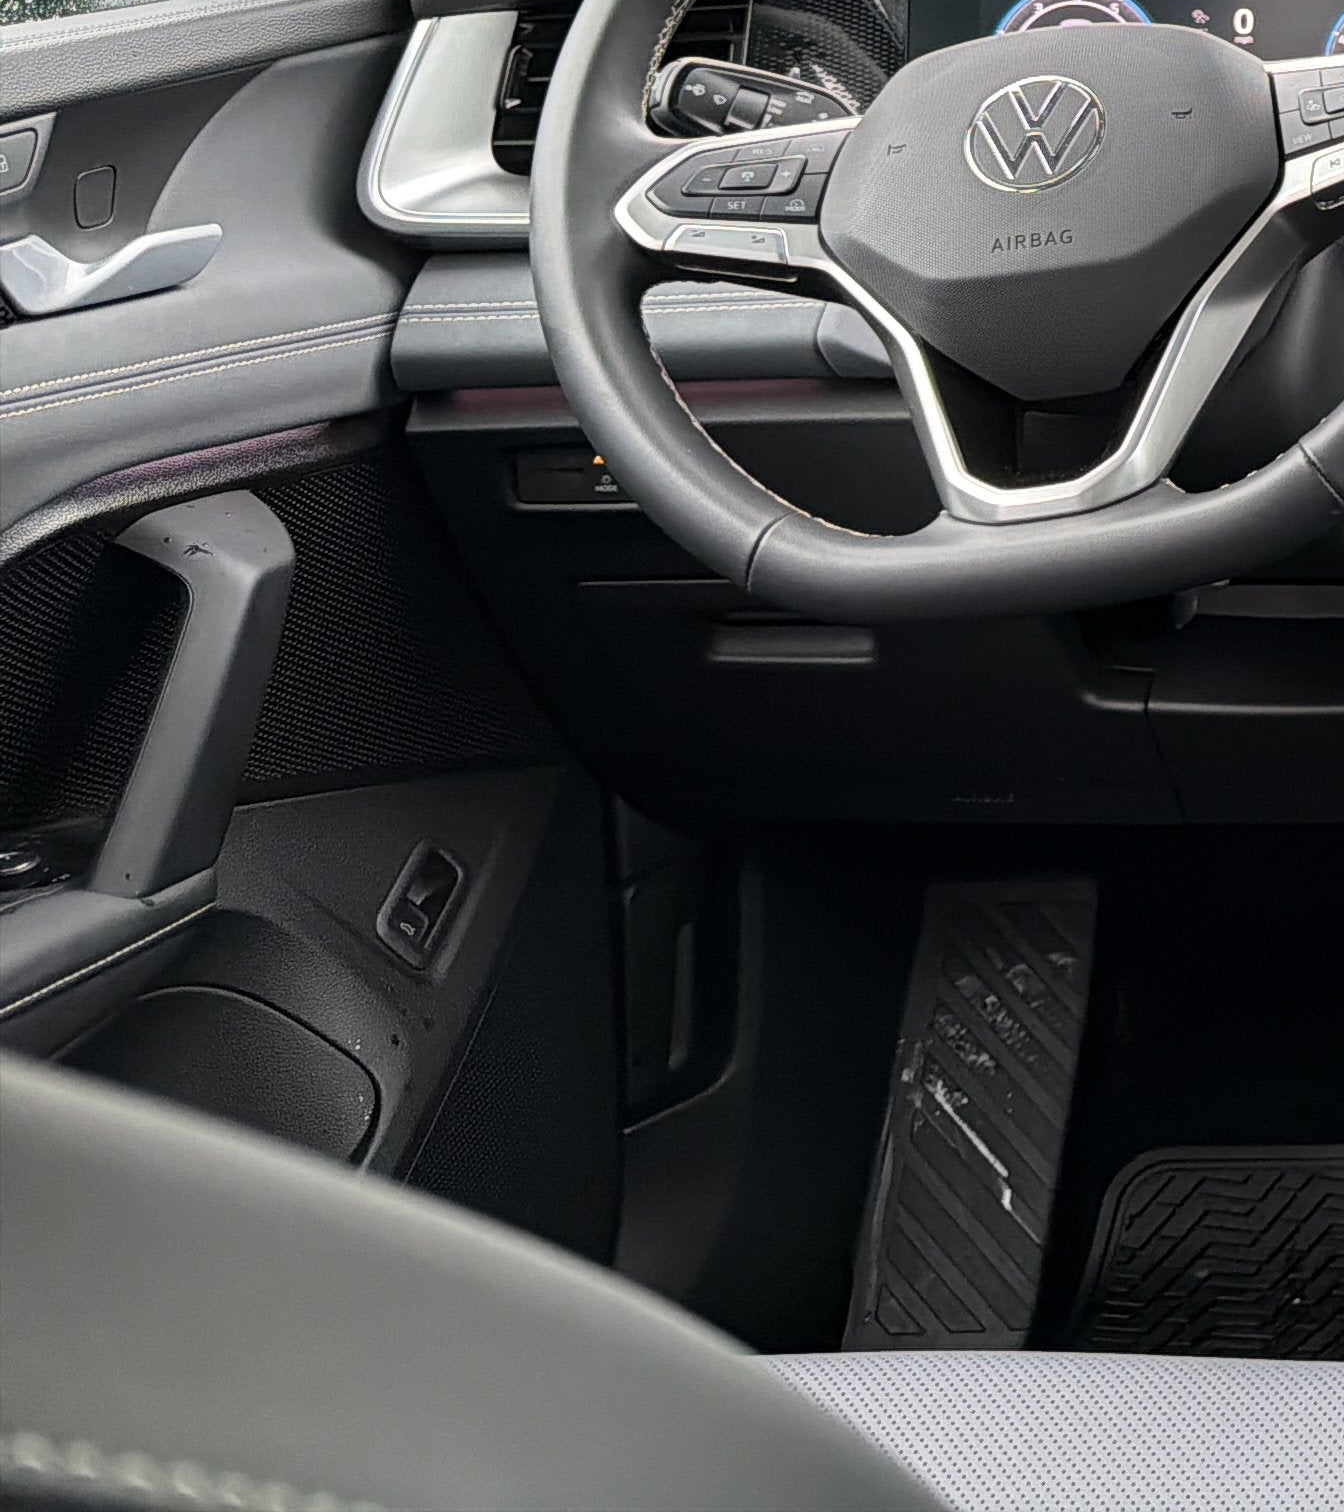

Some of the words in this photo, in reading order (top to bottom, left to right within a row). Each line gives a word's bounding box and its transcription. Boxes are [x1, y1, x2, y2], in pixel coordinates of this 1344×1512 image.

[1232, 7, 1255, 35] 0
[727, 200, 748, 211] SET
[991, 229, 1074, 254] AIRBAG
